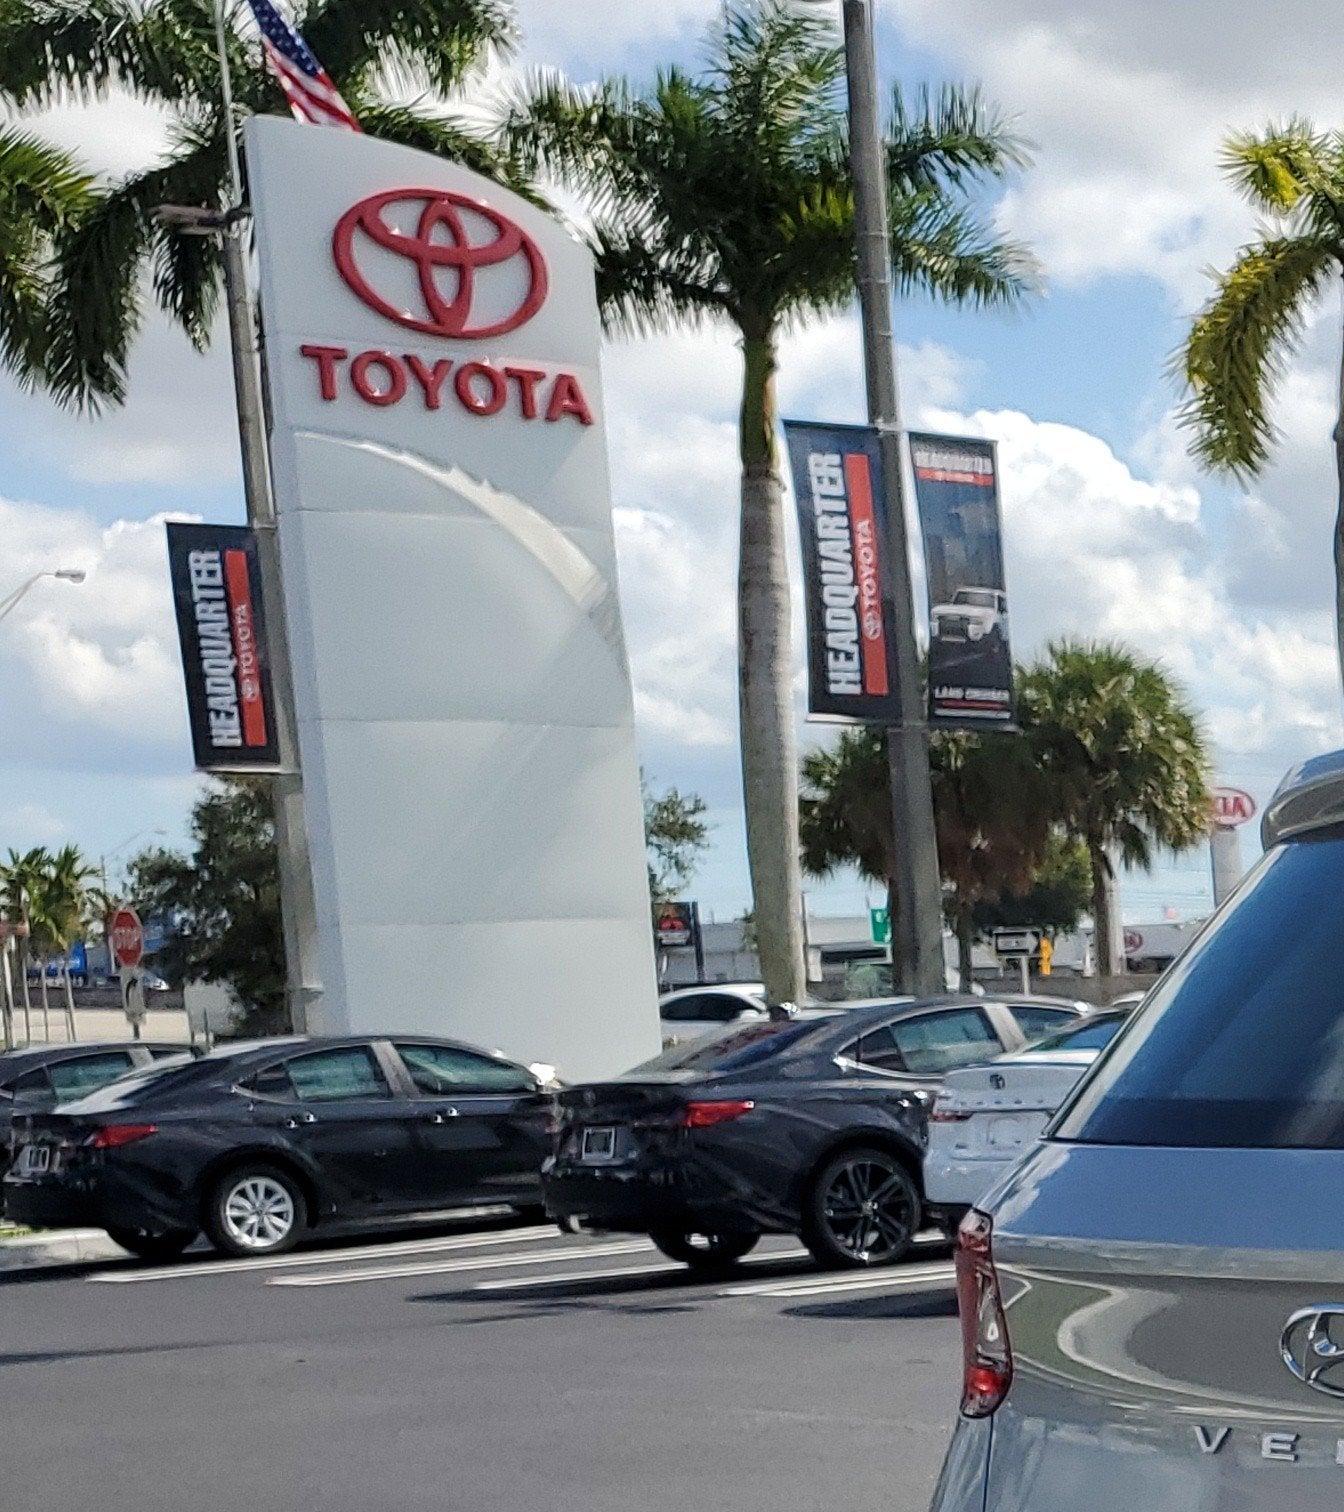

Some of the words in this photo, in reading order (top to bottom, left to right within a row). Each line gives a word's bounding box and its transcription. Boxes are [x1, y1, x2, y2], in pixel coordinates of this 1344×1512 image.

[301, 344, 596, 425] TOYOTA
[808, 453, 862, 696] HEADQUARTER
[857, 518, 879, 610] TOYOTA
[188, 549, 243, 747] HEADQUARTER
[235, 603, 256, 675] TOYOTA
[112, 928, 140, 951] STOP
